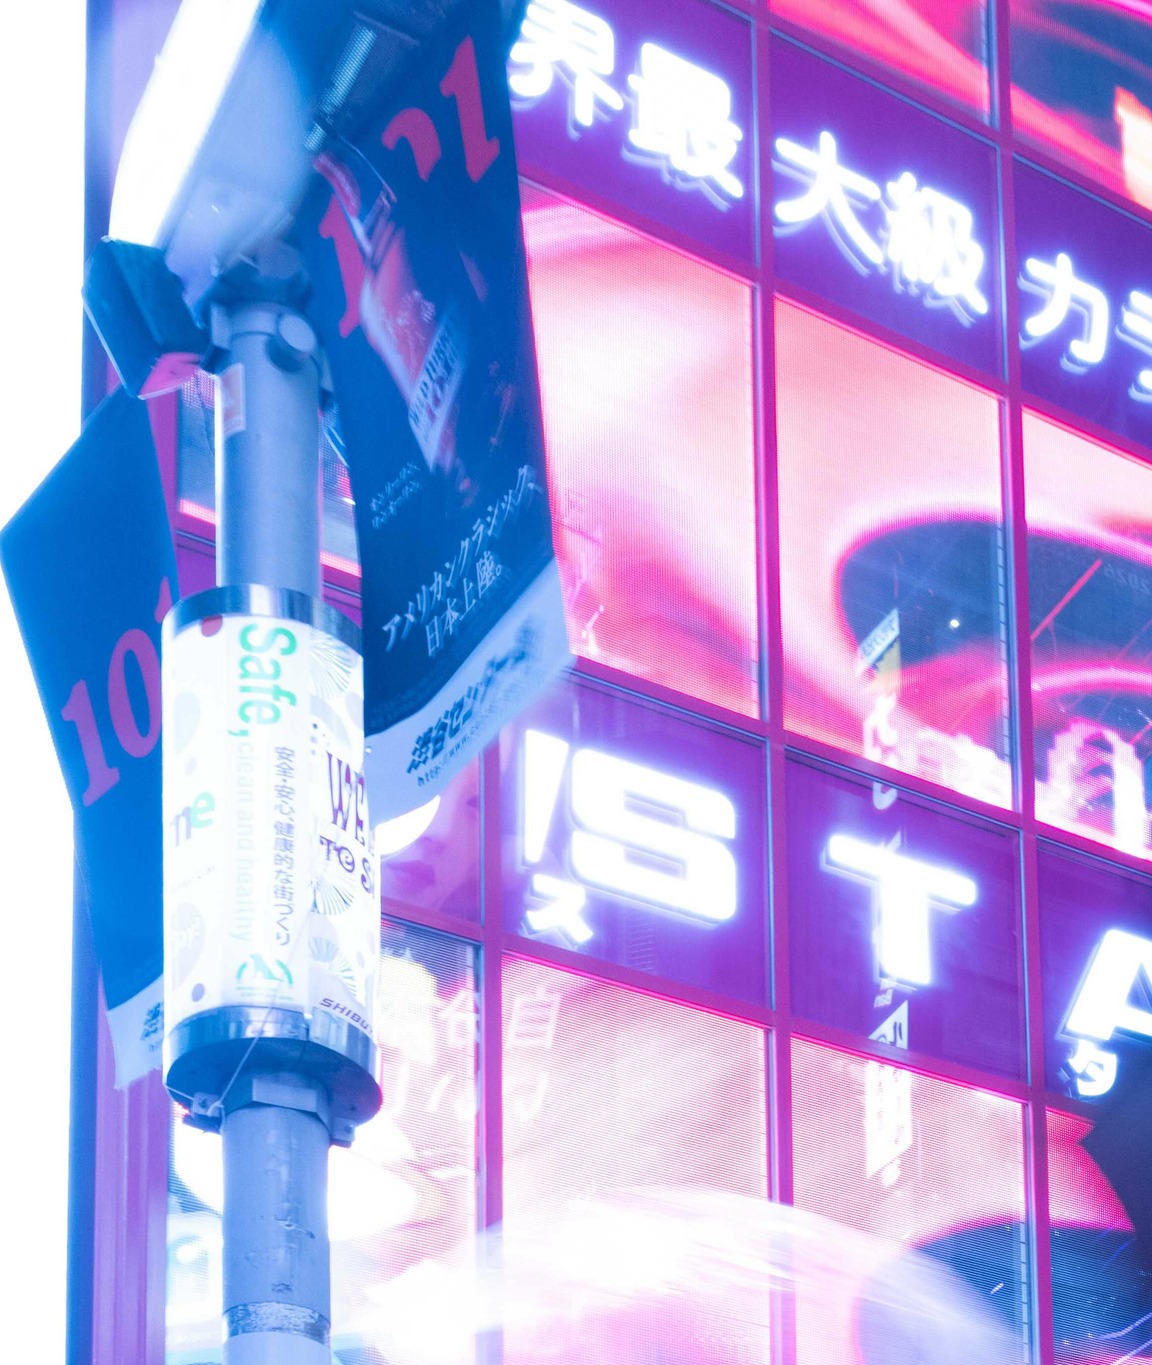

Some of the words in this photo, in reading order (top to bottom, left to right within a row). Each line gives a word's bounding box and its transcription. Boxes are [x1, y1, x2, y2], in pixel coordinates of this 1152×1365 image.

[426, 550, 501, 657] 日本上陸。
[228, 623, 298, 738] Safe,
[325, 750, 373, 857] WE
[320, 997, 374, 1033] SHIBU
